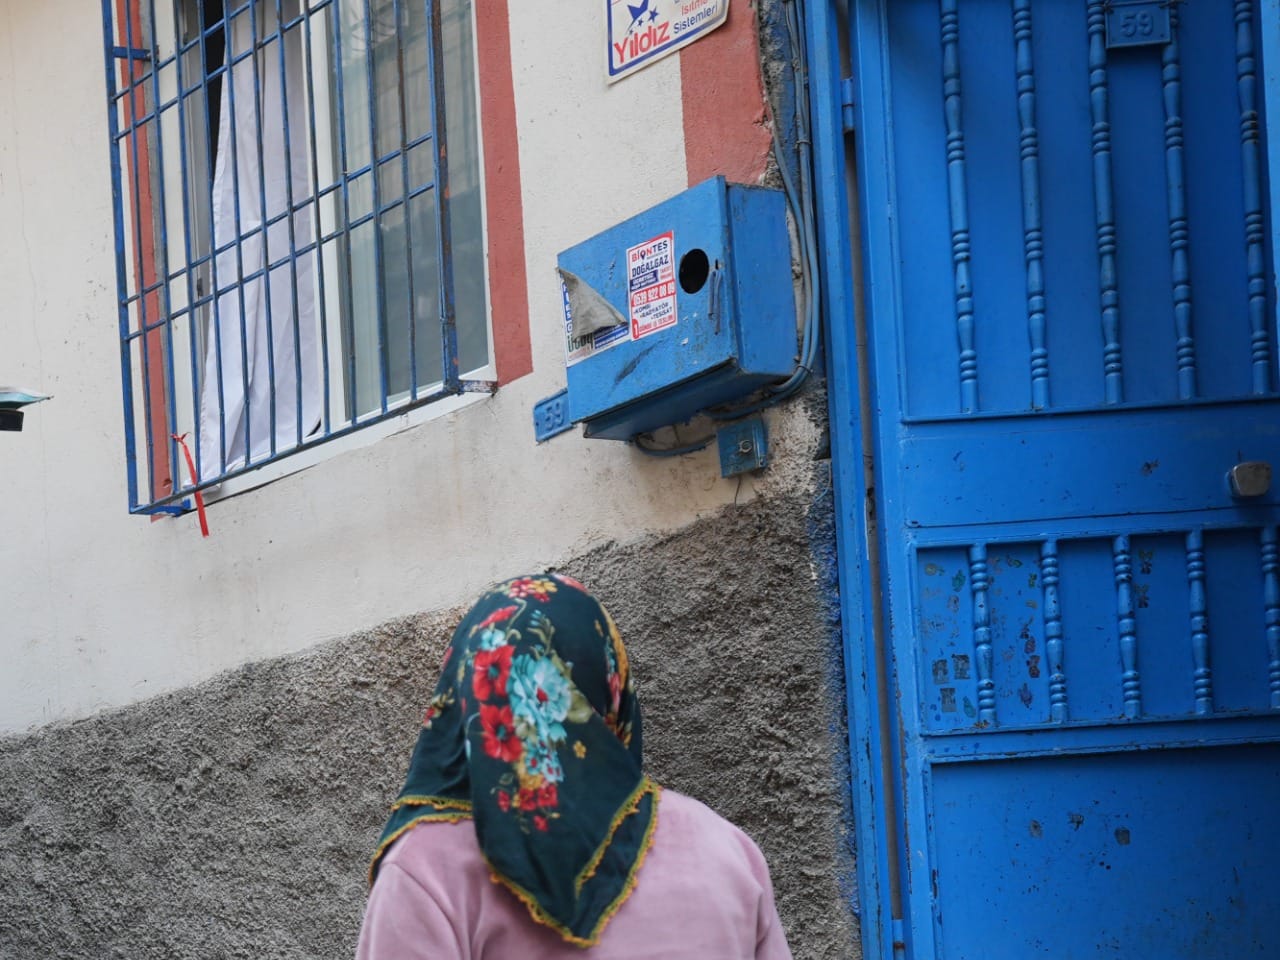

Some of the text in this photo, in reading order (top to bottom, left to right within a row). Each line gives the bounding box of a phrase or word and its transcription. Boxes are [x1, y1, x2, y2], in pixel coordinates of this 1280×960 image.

[673, 4, 718, 34] Sistemleri
[1121, 11, 1153, 37] 59
[614, 21, 670, 63] Yıldız
[545, 401, 564, 432] 59
